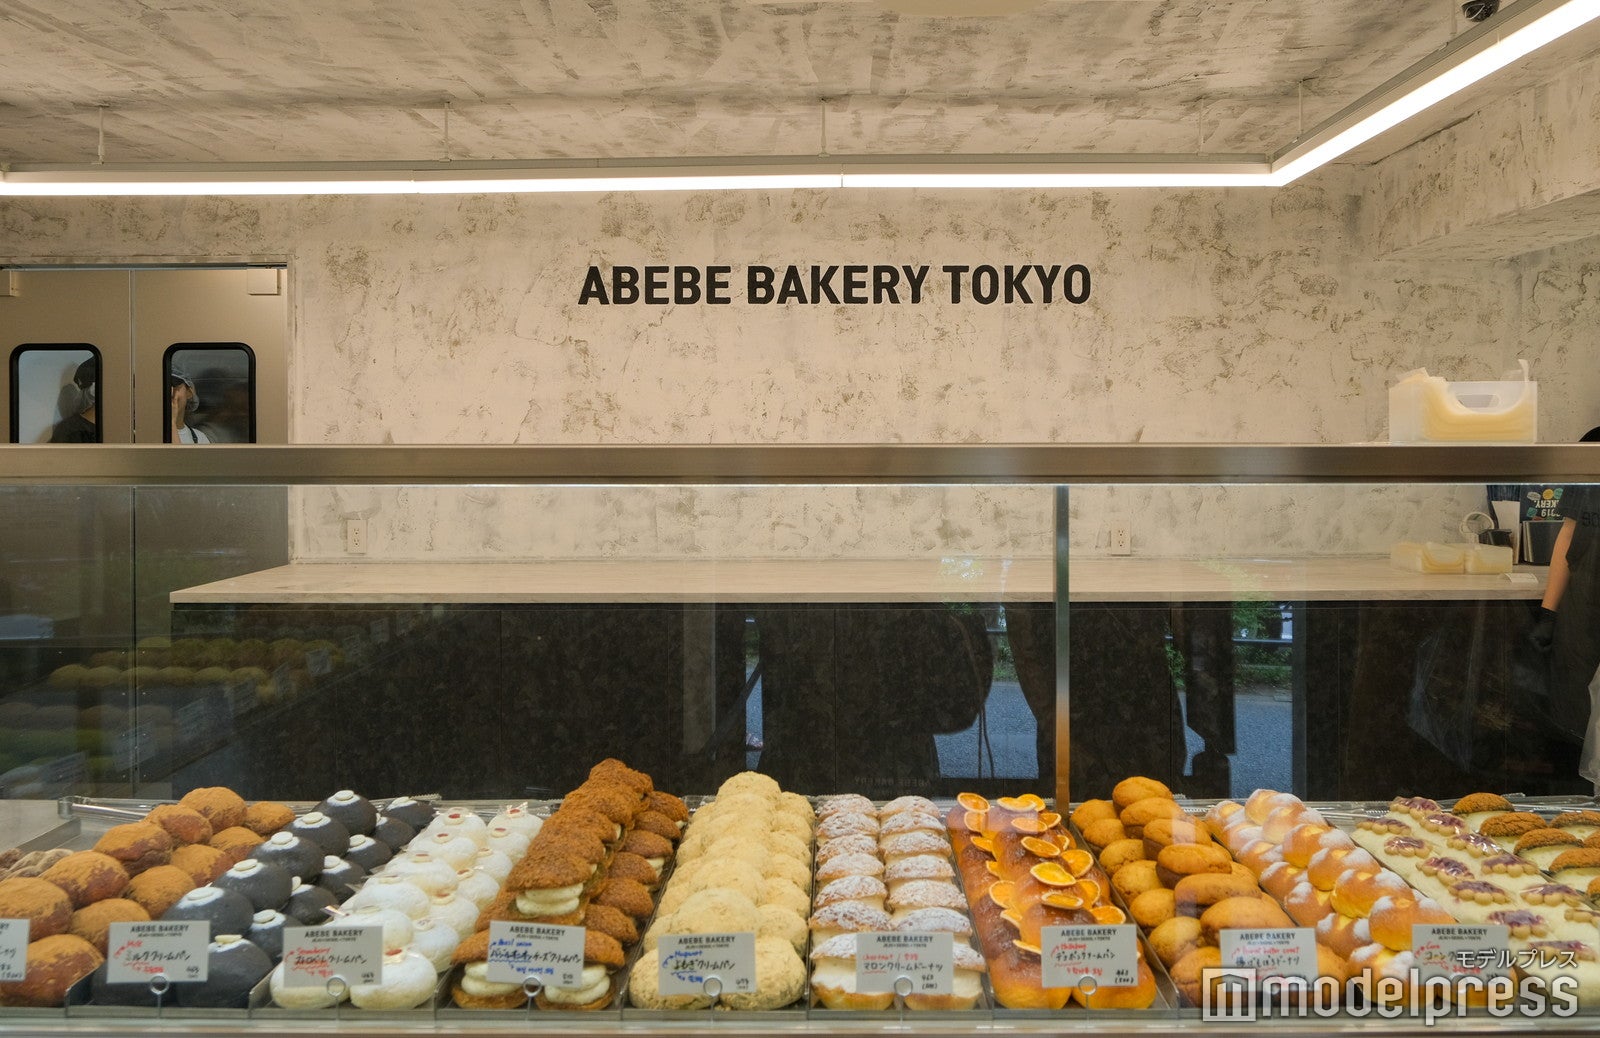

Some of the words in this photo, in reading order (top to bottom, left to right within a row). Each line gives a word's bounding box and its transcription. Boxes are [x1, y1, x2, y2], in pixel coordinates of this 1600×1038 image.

[579, 265, 731, 304] ABEBE
[747, 265, 932, 304] BAKERY
[943, 264, 1091, 303] TOKYO
[509, 926, 534, 934] ABEBE
[536, 928, 565, 936] BAKERY
[863, 962, 943, 972] マロンクリームドーナツ
